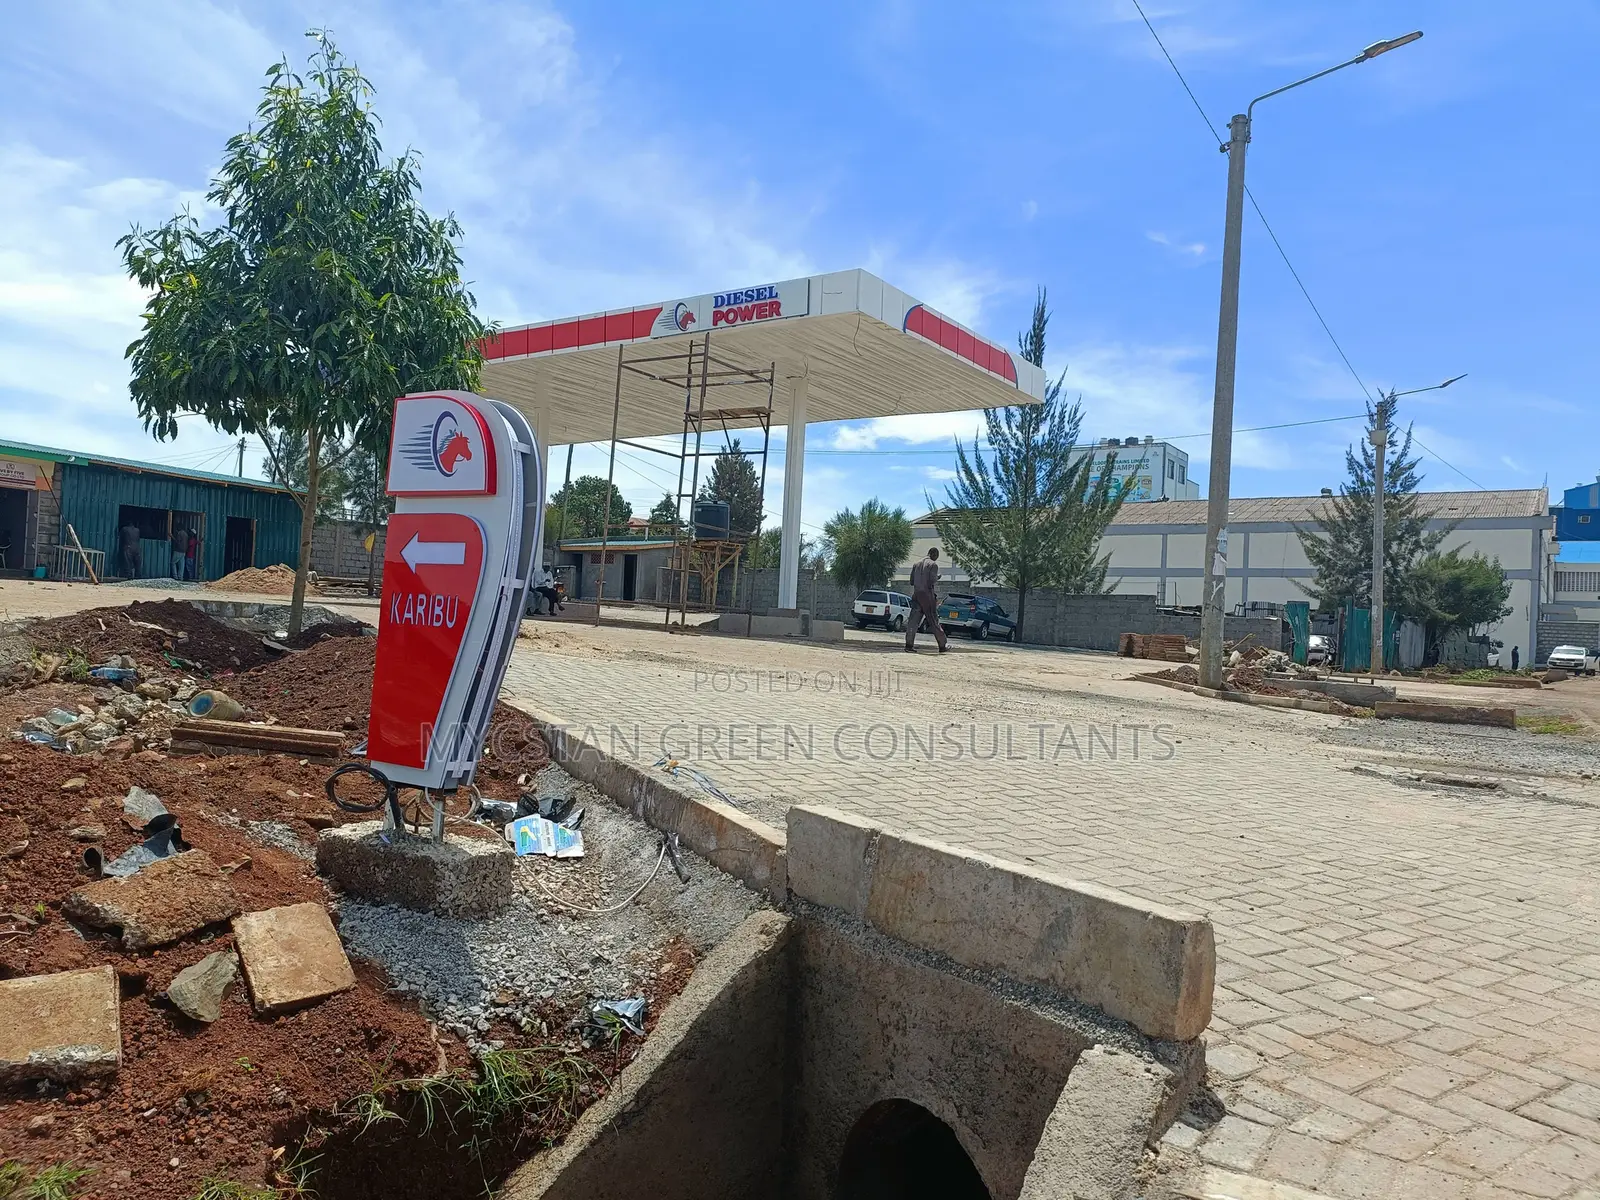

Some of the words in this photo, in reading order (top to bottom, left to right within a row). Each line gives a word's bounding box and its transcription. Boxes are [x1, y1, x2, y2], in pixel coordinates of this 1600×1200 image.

[713, 286, 778, 308] DIESEL
[712, 301, 781, 326] POWER
[390, 592, 459, 628] KARIBU
